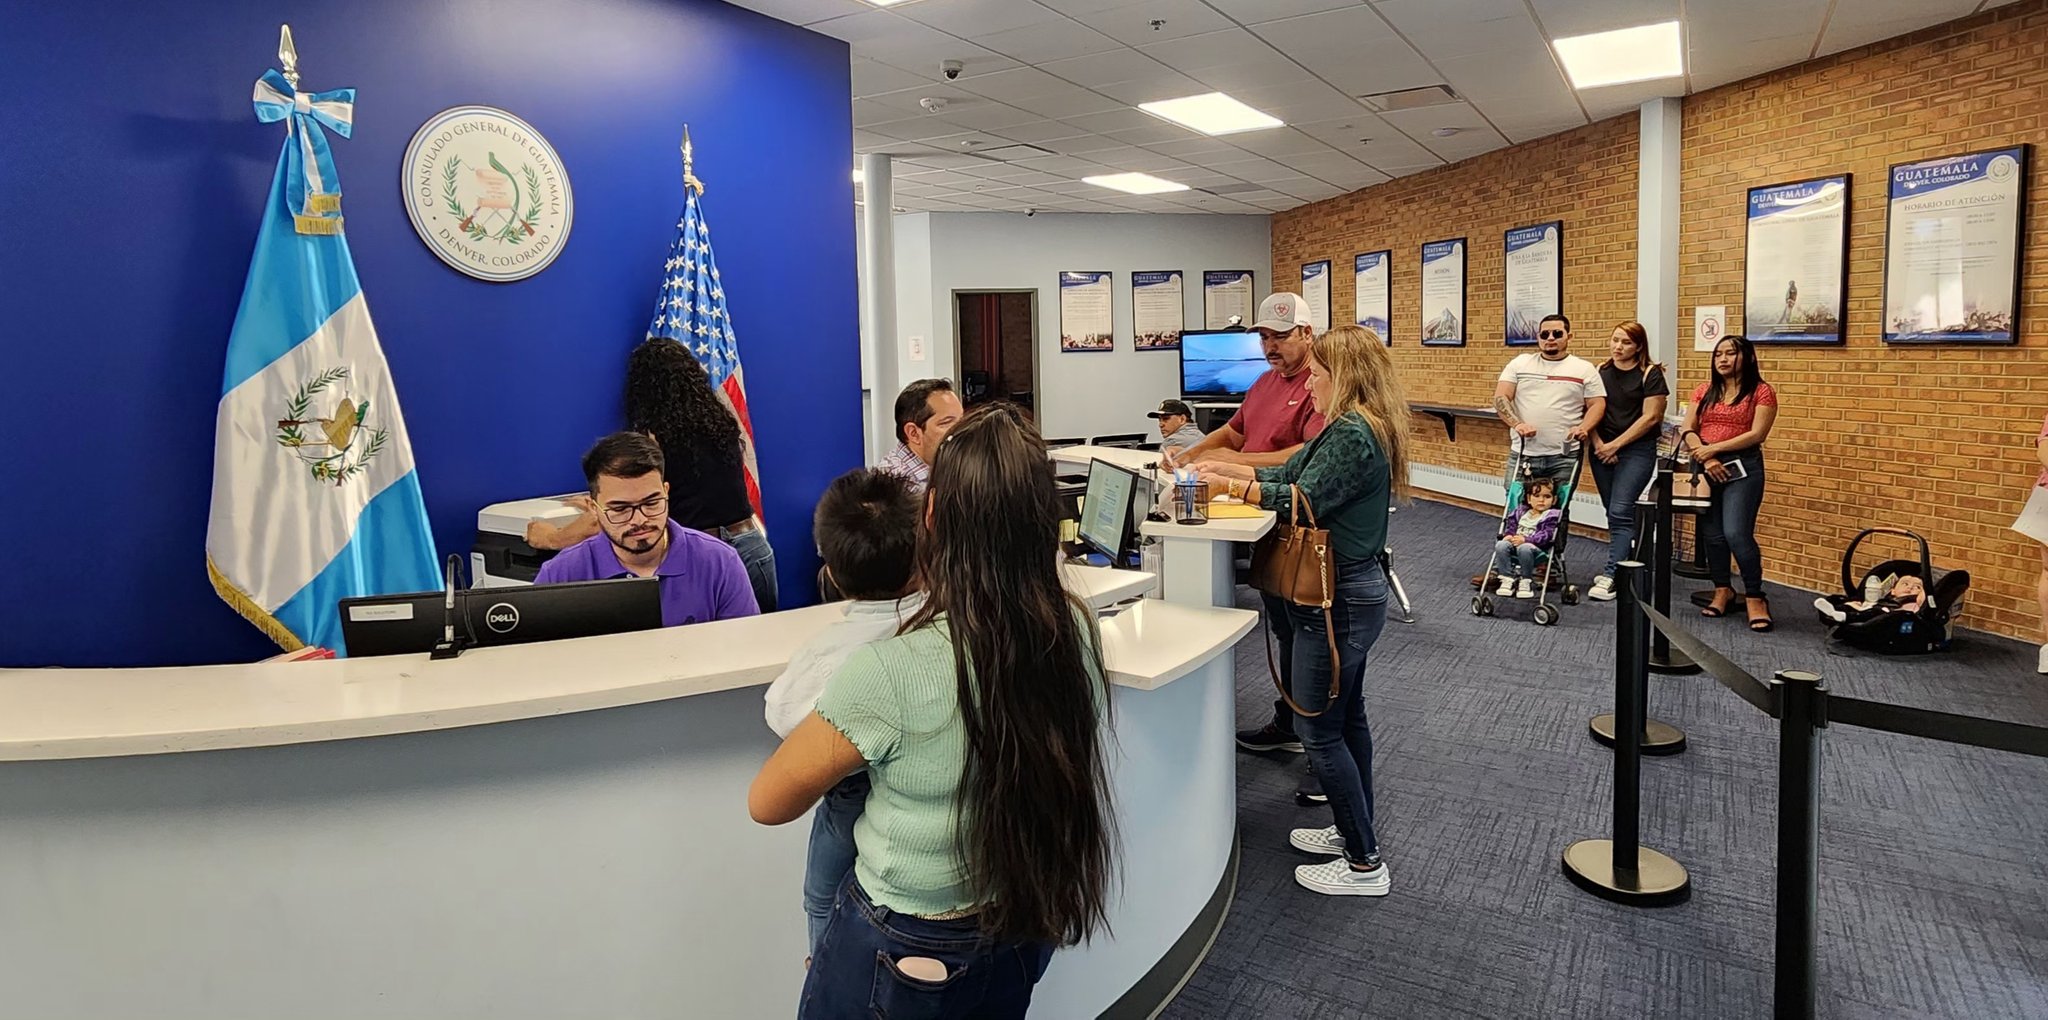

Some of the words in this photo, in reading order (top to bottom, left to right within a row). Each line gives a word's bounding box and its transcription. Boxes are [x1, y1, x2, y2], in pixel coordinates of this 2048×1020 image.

[421, 131, 453, 207] CONSULADO
[453, 121, 509, 137] GENERAL
[512, 133, 528, 148] DE
[528, 146, 560, 216] GUATEMALA
[1895, 162, 1979, 182] GUATEMALA
[1931, 173, 1971, 184] COLORADO
[1751, 187, 1815, 204] GUATEMALA
[1904, 200, 1943, 211] HORARIO
[1945, 198, 1956, 206] DE
[1959, 193, 2006, 205] ATENCIÓN
[1507, 230, 1542, 242] GUATEMALA
[492, 234, 550, 266] COLORADO
[490, 613, 516, 623] DELL
